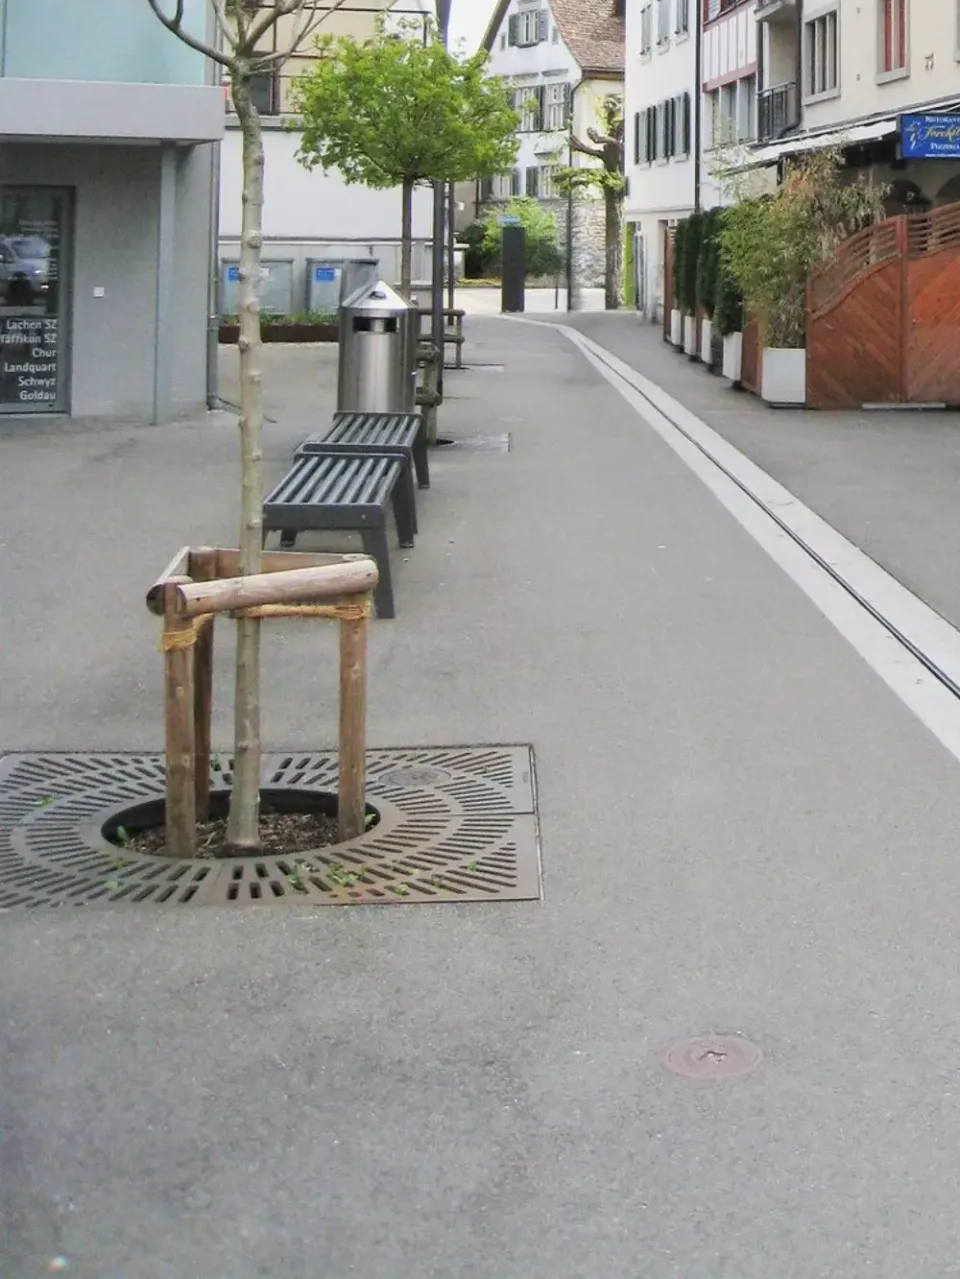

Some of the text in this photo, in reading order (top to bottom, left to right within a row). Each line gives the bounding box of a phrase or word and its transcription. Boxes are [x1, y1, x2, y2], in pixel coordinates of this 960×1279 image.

[6, 319, 57, 330] Lachen SZ
[44, 333, 57, 344] SZ
[31, 347, 57, 358] Chur
[4, 361, 57, 374] Landquart
[17, 375, 56, 388] Schwyz
[19, 390, 56, 401] Goldau
